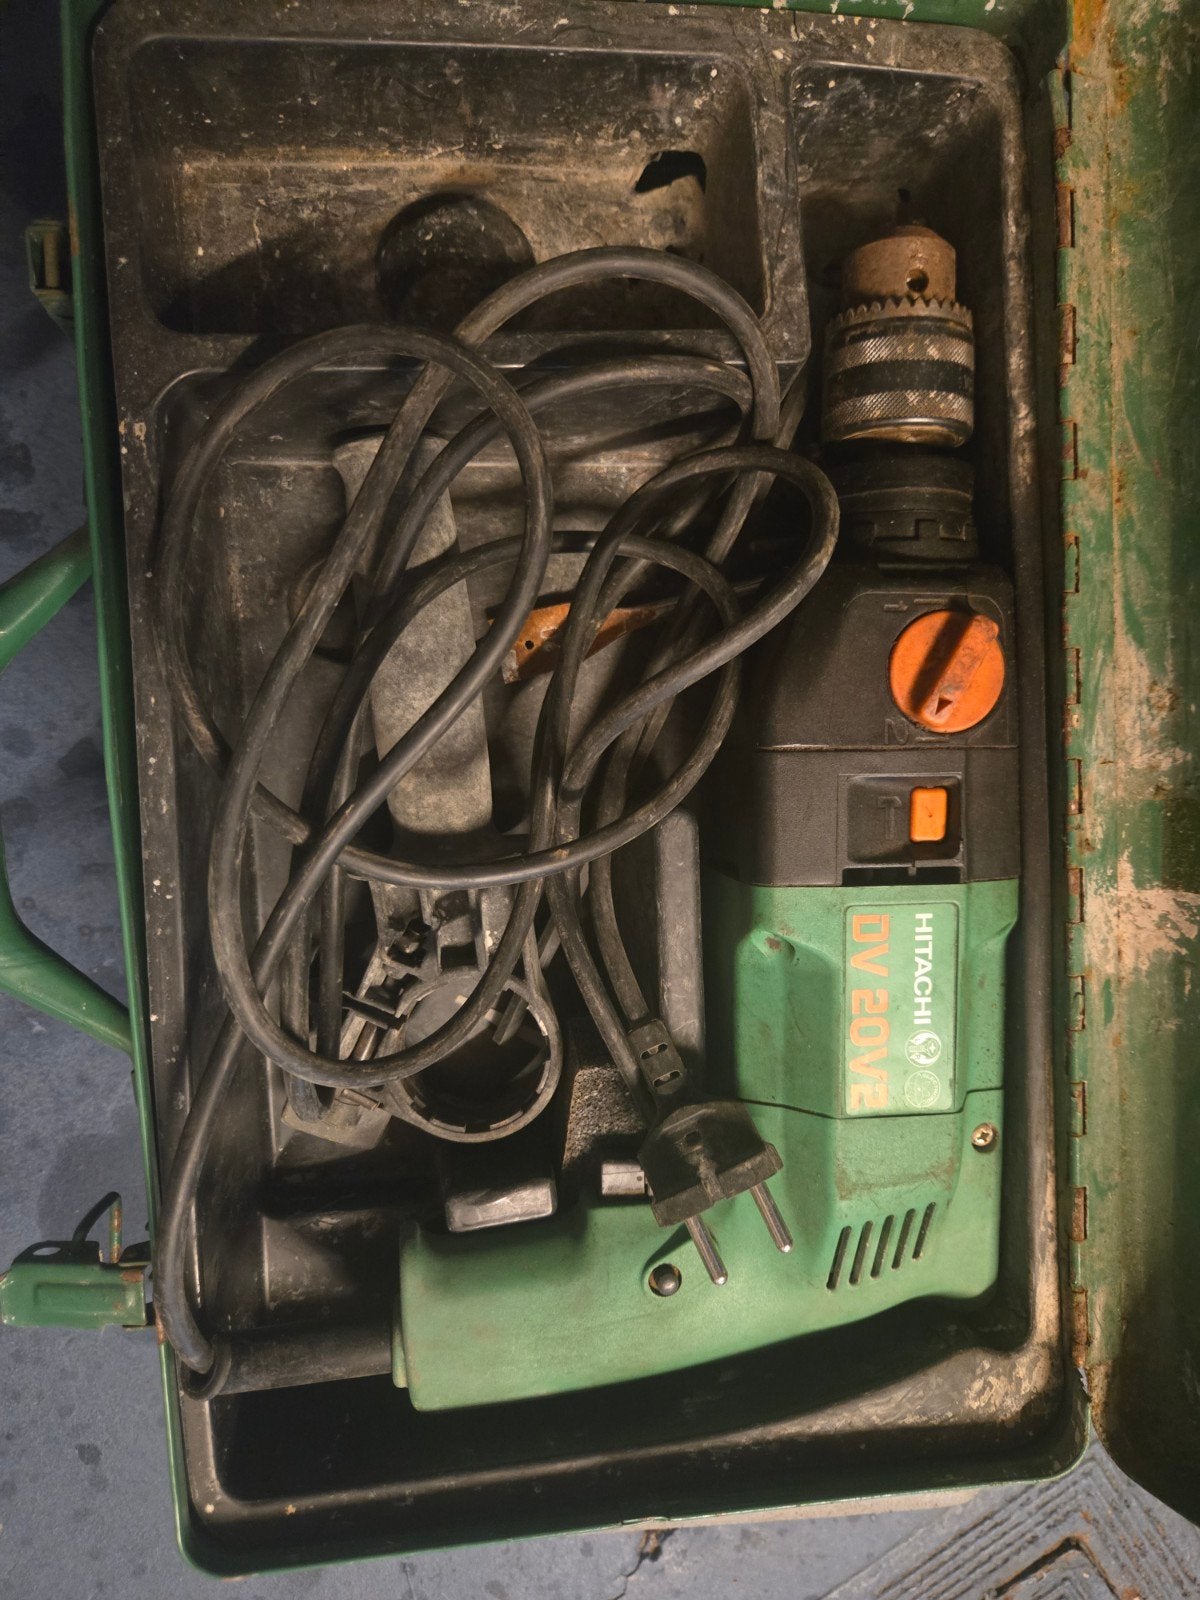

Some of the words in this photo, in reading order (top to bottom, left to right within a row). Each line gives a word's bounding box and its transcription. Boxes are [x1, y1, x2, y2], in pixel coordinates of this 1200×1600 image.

[850, 914, 890, 977] DV
[913, 913, 934, 1025] HITACHI
[849, 988, 890, 1110] 20V2
